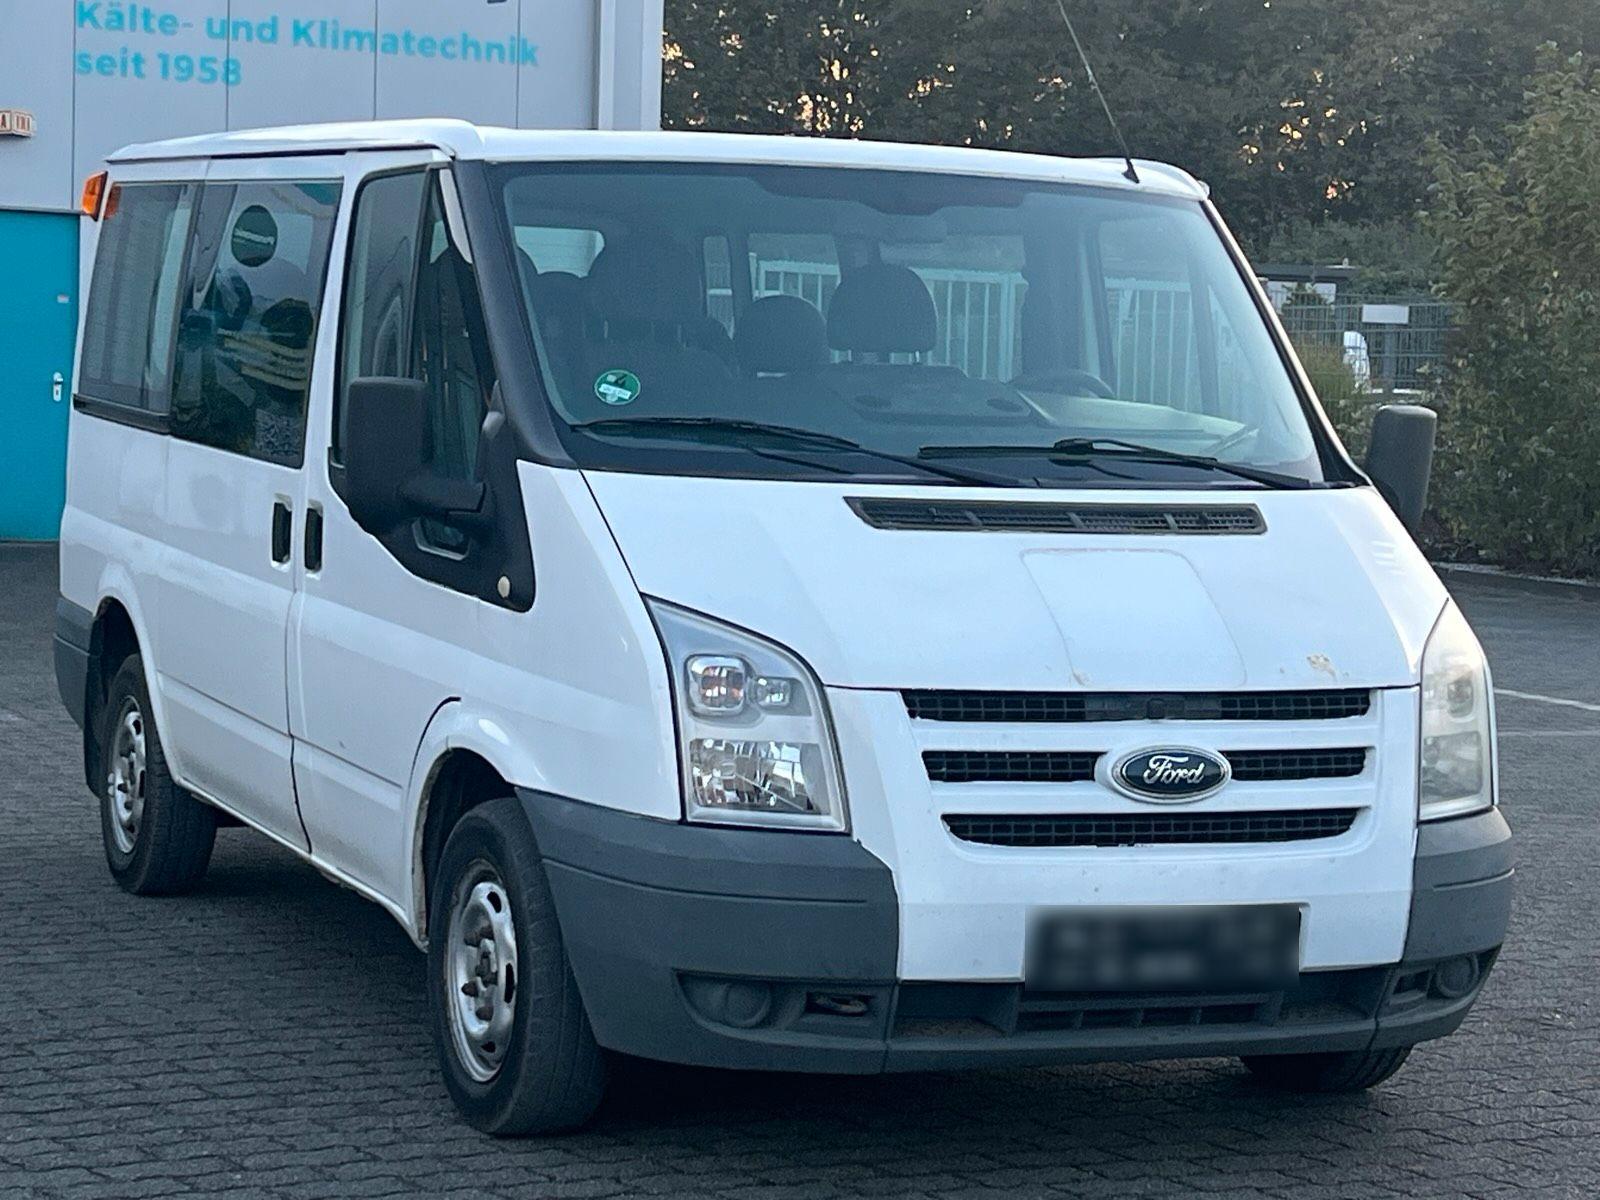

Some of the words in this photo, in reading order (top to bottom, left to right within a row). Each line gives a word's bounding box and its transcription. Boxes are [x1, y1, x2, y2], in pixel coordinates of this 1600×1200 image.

[76, 1, 193, 36] Kälte-
[206, 15, 278, 44] und
[292, 19, 539, 67] Klimatechnik
[76, 46, 146, 79] seit
[157, 51, 242, 86] 1958
[1143, 755, 1205, 784] Ford
